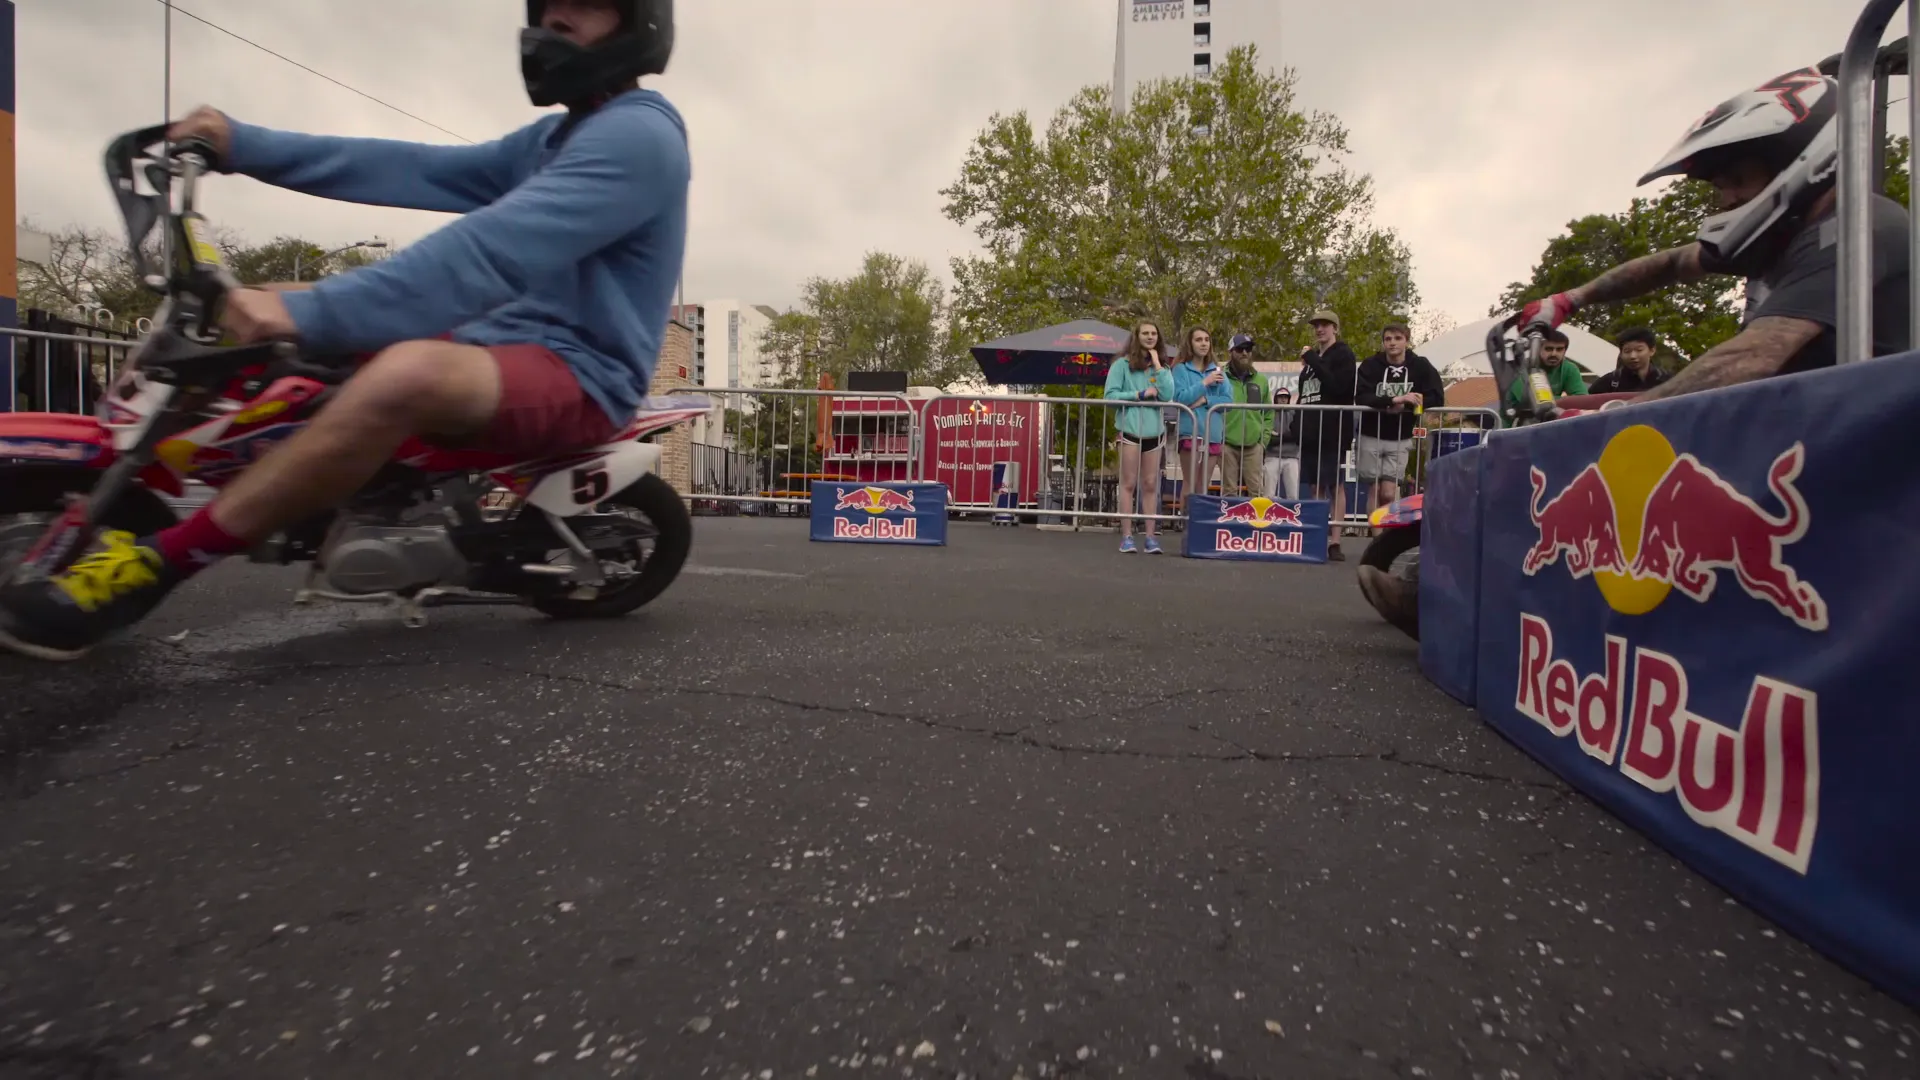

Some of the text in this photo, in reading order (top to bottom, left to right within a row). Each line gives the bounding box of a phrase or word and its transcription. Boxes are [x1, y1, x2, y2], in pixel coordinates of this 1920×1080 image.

[1132, 12, 1184, 22] CAMPUS
[1133, 3, 1184, 13] AMERICAN
[572, 460, 609, 505] 5
[834, 516, 916, 539] Red Bull
[1216, 529, 1303, 555] Red Bull
[1515, 611, 1820, 876] Red Bull
